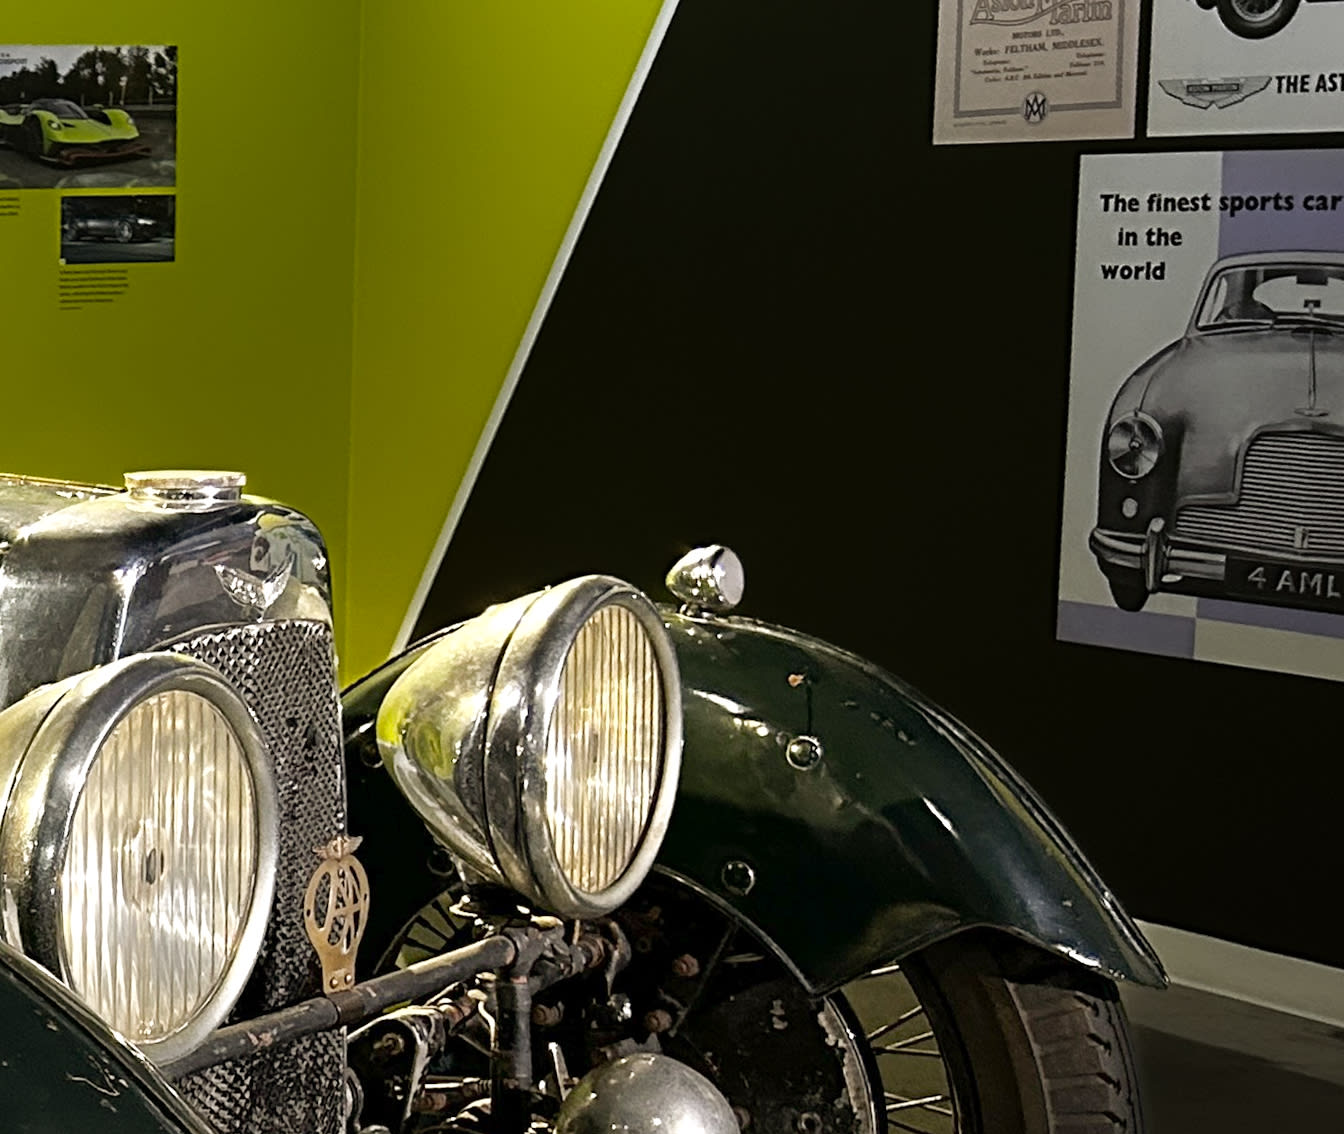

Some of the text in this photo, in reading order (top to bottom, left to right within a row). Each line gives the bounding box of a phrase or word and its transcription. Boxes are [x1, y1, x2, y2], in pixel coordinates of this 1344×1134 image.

[1276, 75, 1310, 93] THE
[1100, 194, 1139, 212] The
[1147, 193, 1210, 212] finest
[1219, 193, 1294, 217] sports
[1118, 228, 1183, 246] in the
[1101, 261, 1166, 281] world
[1248, 567, 1341, 597] 4 AML
